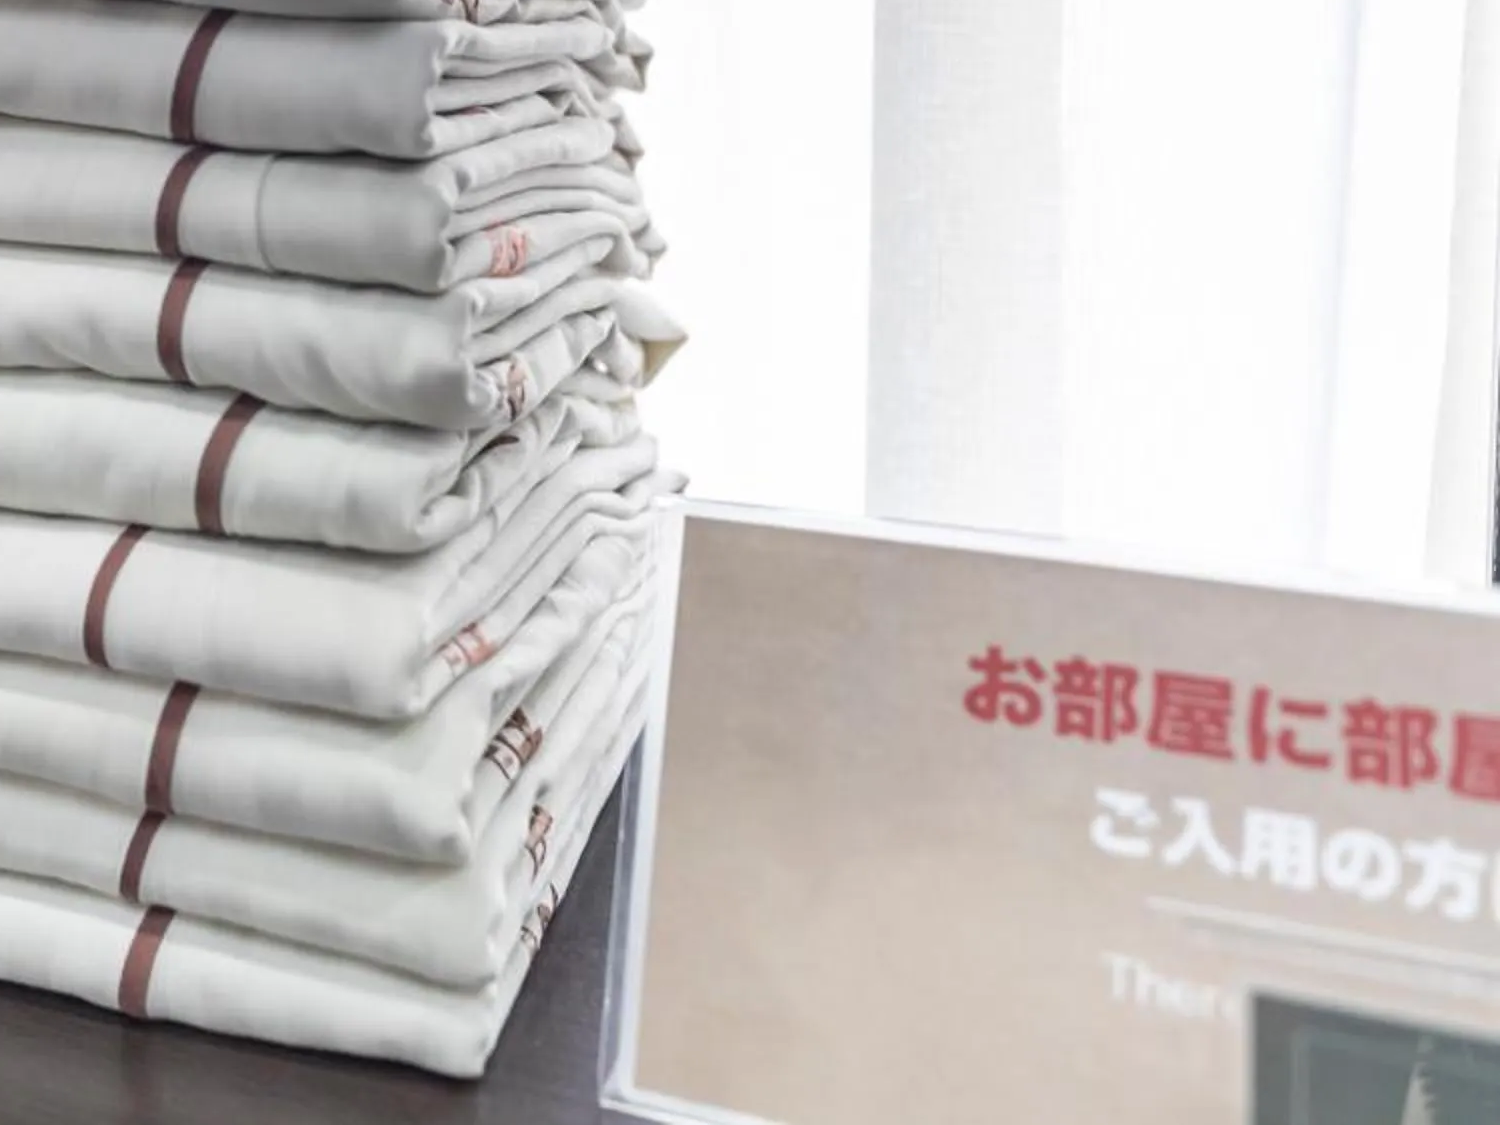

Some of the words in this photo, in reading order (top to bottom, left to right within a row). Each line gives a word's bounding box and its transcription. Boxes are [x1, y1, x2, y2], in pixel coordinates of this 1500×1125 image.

[1089, 787, 1500, 923] ご入用の方
